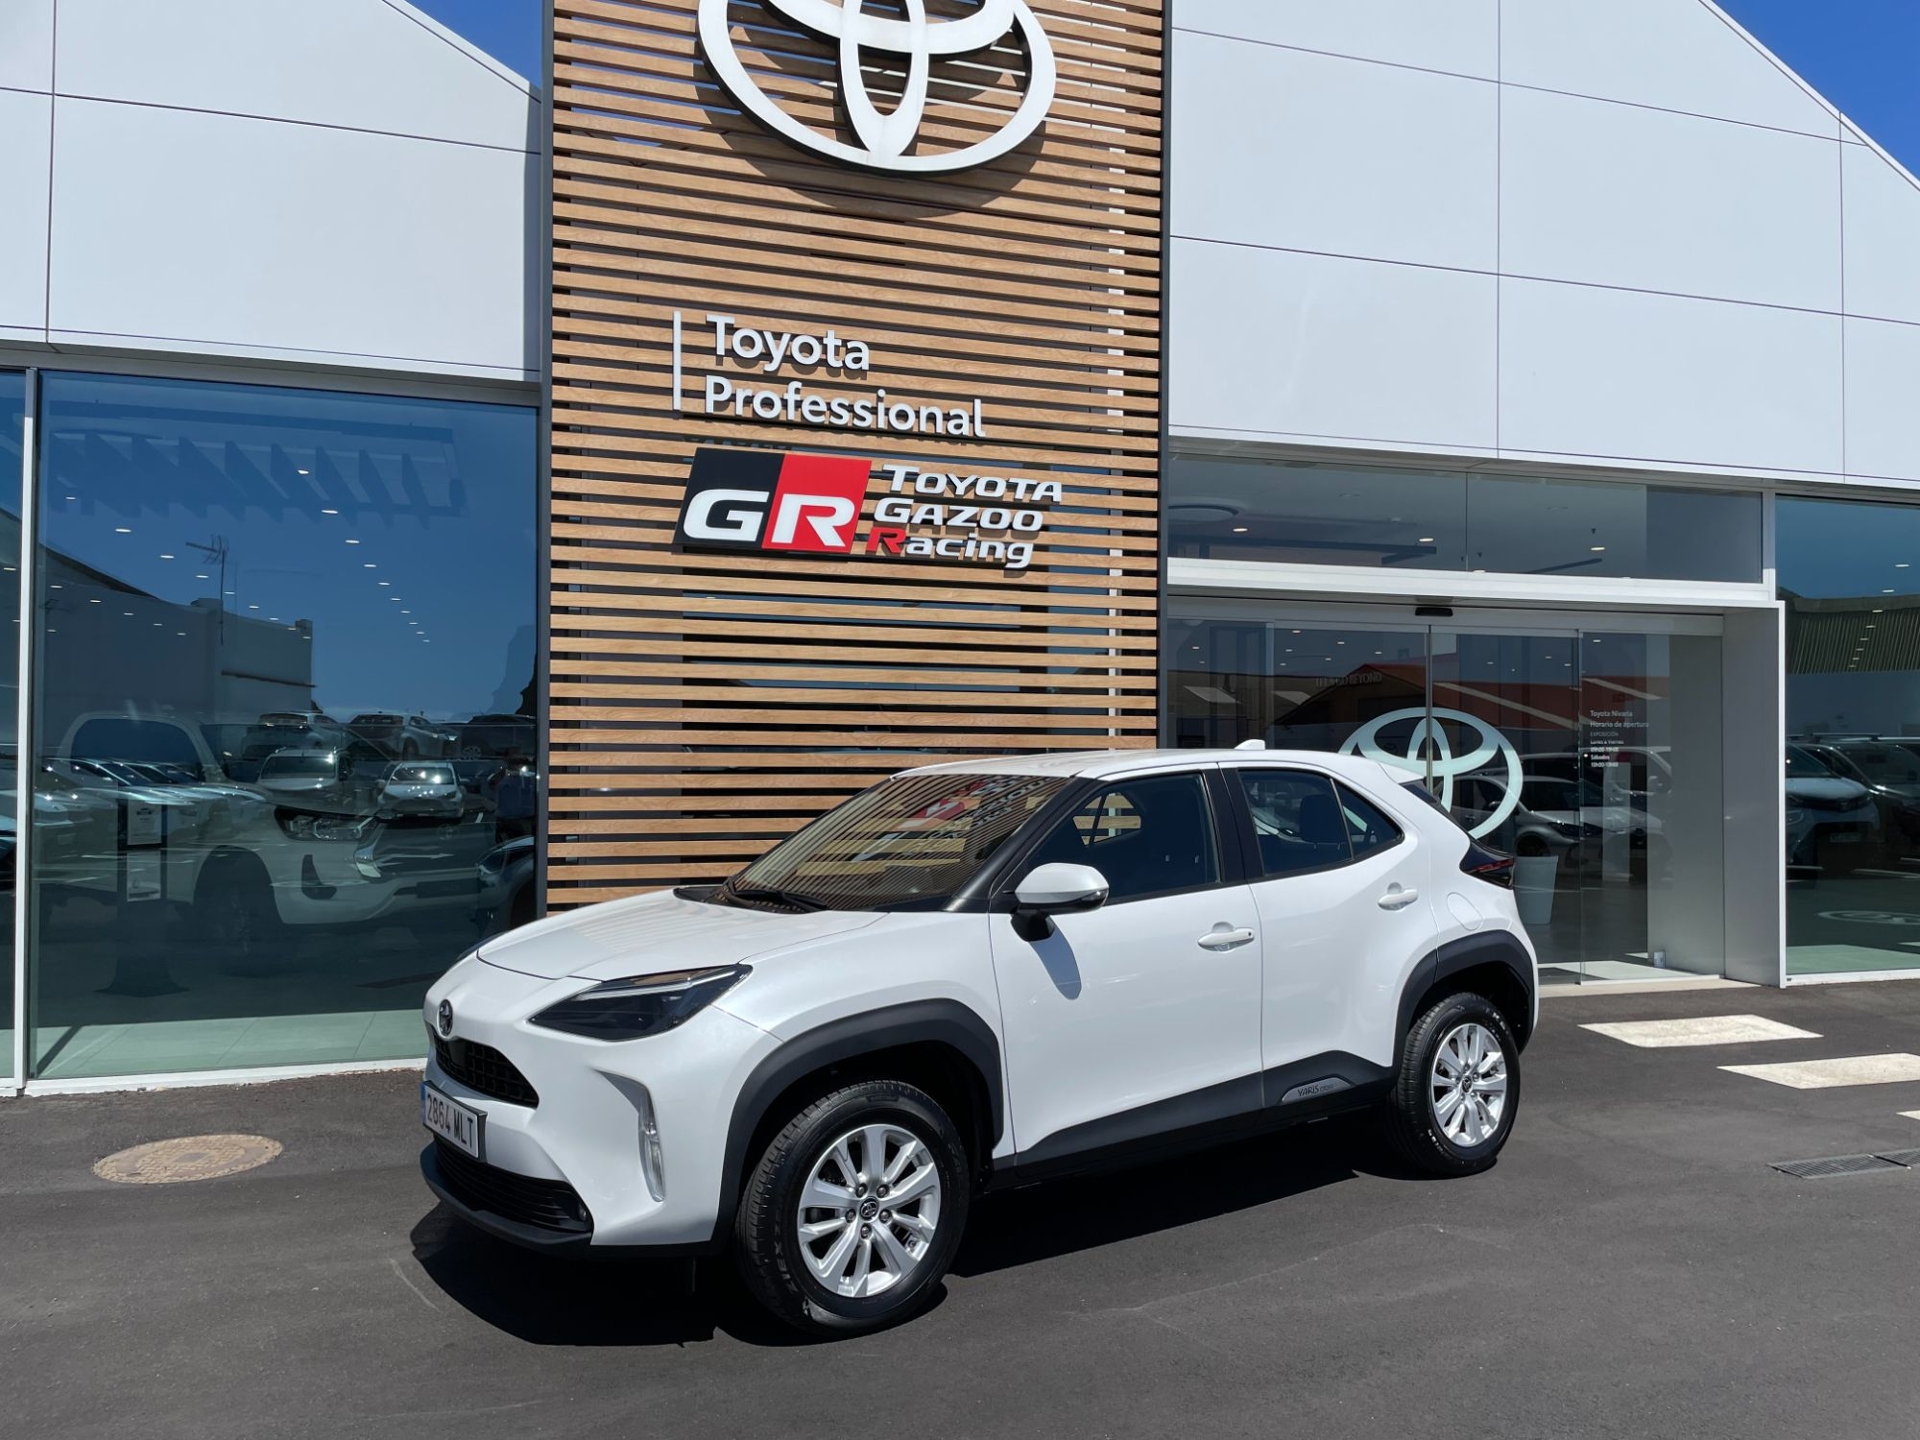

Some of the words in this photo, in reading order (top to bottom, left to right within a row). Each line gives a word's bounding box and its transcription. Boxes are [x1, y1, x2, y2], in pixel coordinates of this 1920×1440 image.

[706, 314, 870, 372] Toyota
[705, 374, 986, 438] Professional
[882, 464, 1063, 503] TOYOTA
[682, 488, 855, 548] GR
[874, 497, 1044, 533] GAZOO
[866, 526, 1035, 570] Racing
[1590, 710, 1610, 718] Toyota
[1623, 721, 1649, 729] apertura
[427, 1093, 451, 1135] 2864
[453, 1108, 474, 1149] MLT
